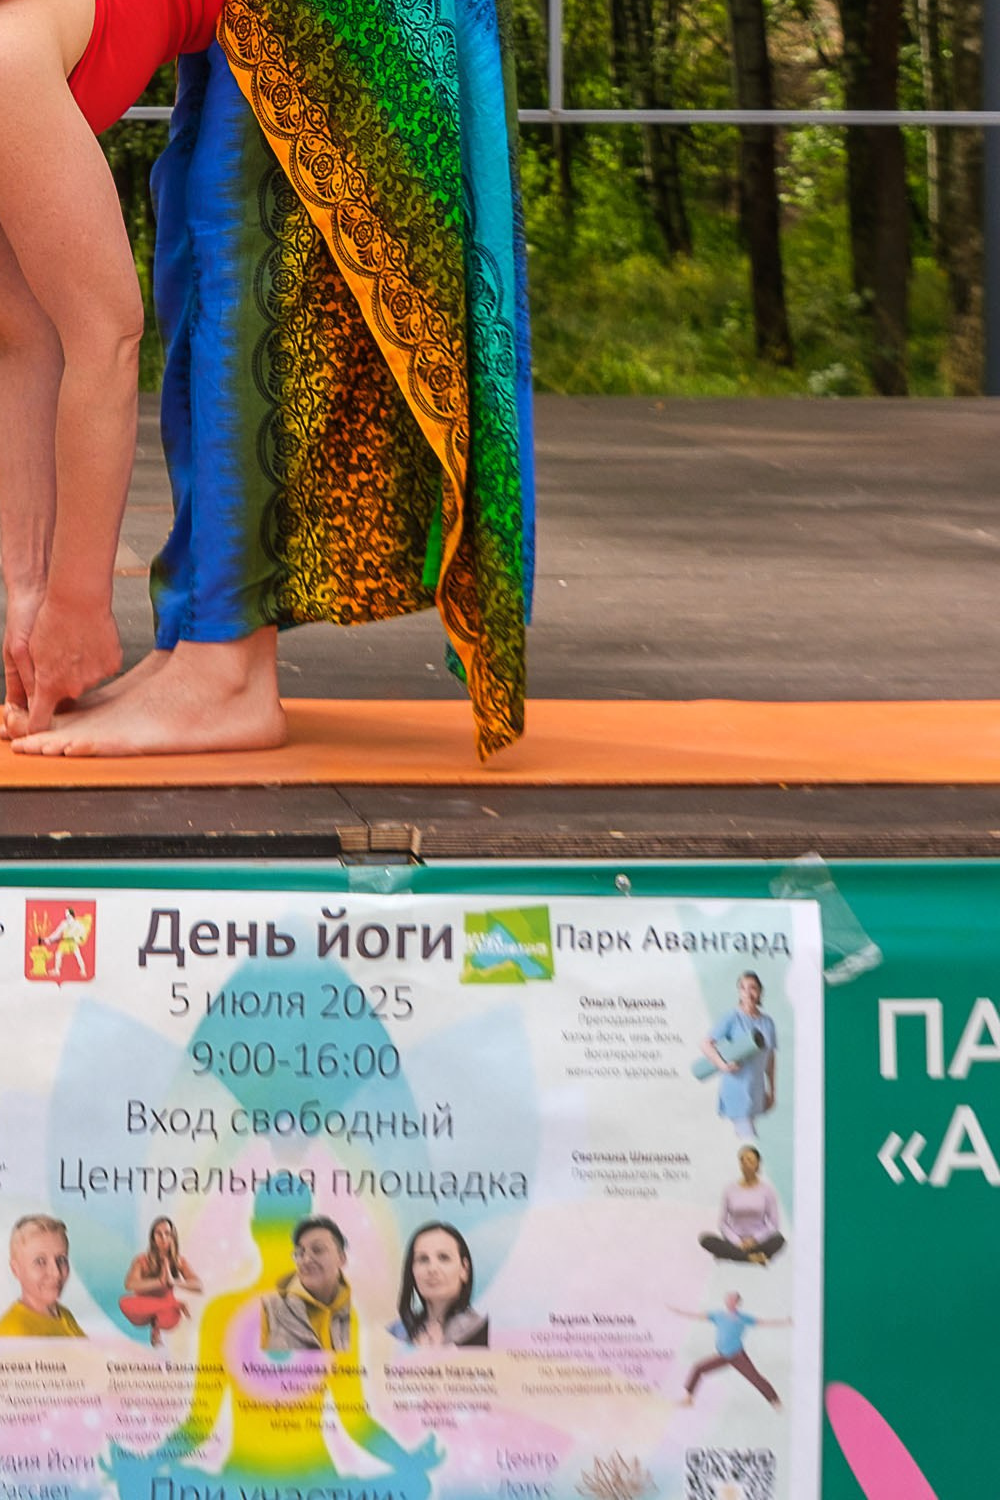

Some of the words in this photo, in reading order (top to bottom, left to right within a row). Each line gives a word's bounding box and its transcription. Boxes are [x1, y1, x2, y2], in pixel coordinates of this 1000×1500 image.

[137, 907, 297, 968] День
[316, 907, 454, 960] йоги
[556, 923, 631, 957] Парк
[642, 925, 792, 960] Авангард
[168, 982, 190, 1017] 5
[206, 990, 305, 1019] июля
[320, 984, 414, 1021] 2025
[579, 996, 616, 1010] Ольга
[192, 1041, 400, 1078] 9:00-16:00
[127, 1101, 218, 1141] Вход
[230, 1102, 455, 1144] свободный
[59, 1157, 317, 1201] Центральная
[331, 1167, 529, 1207] площадка
[35, 1361, 68, 1373] Нина
[331, 1362, 368, 1376] Елена
[383, 1363, 442, 1379] Борисова
